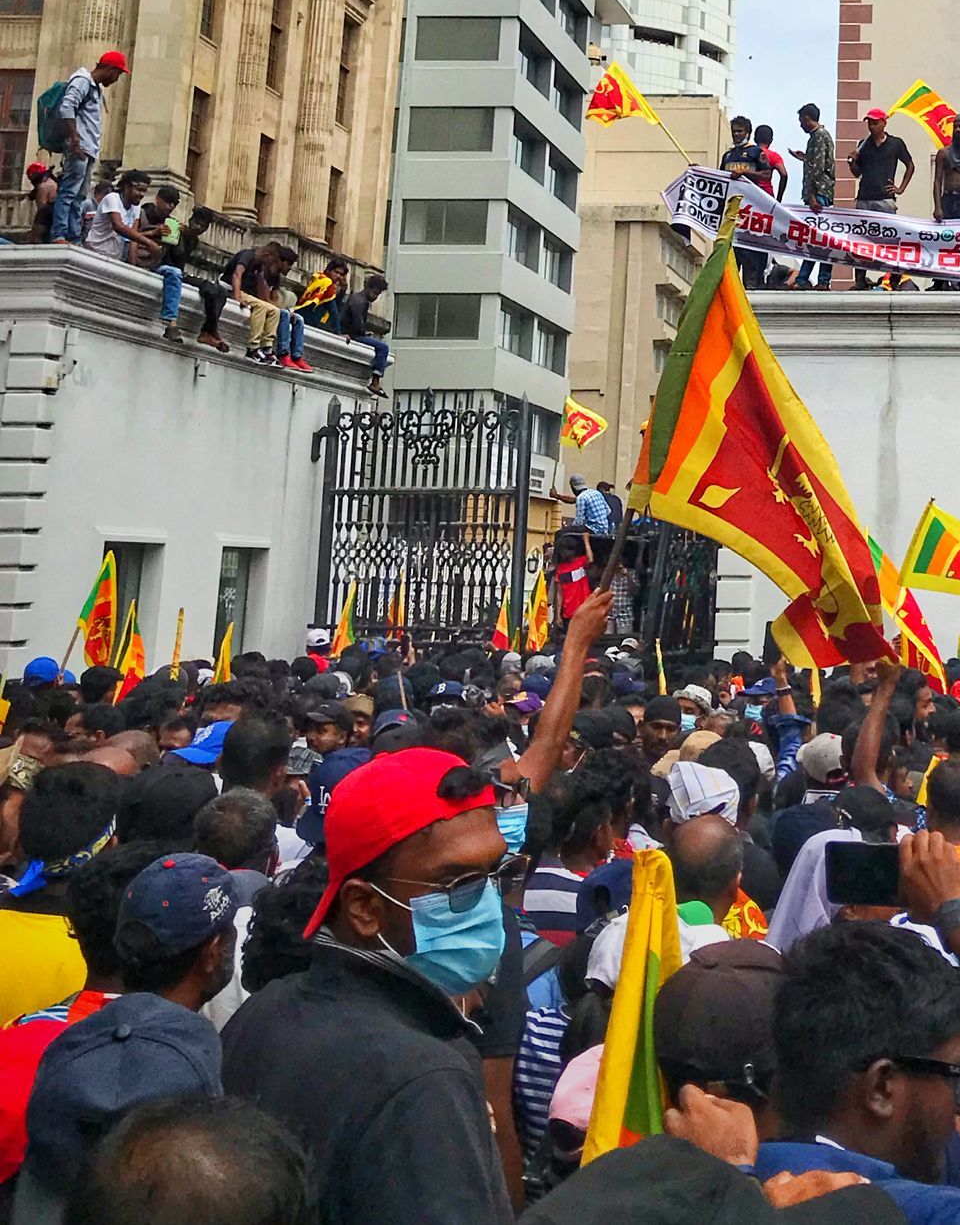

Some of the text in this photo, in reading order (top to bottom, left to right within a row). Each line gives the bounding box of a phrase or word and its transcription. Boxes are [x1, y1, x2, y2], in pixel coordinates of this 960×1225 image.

[684, 175, 724, 197] GOTA
[685, 189, 719, 212] GO
[675, 202, 720, 229] HOME
[436, 681, 447, 694] B
